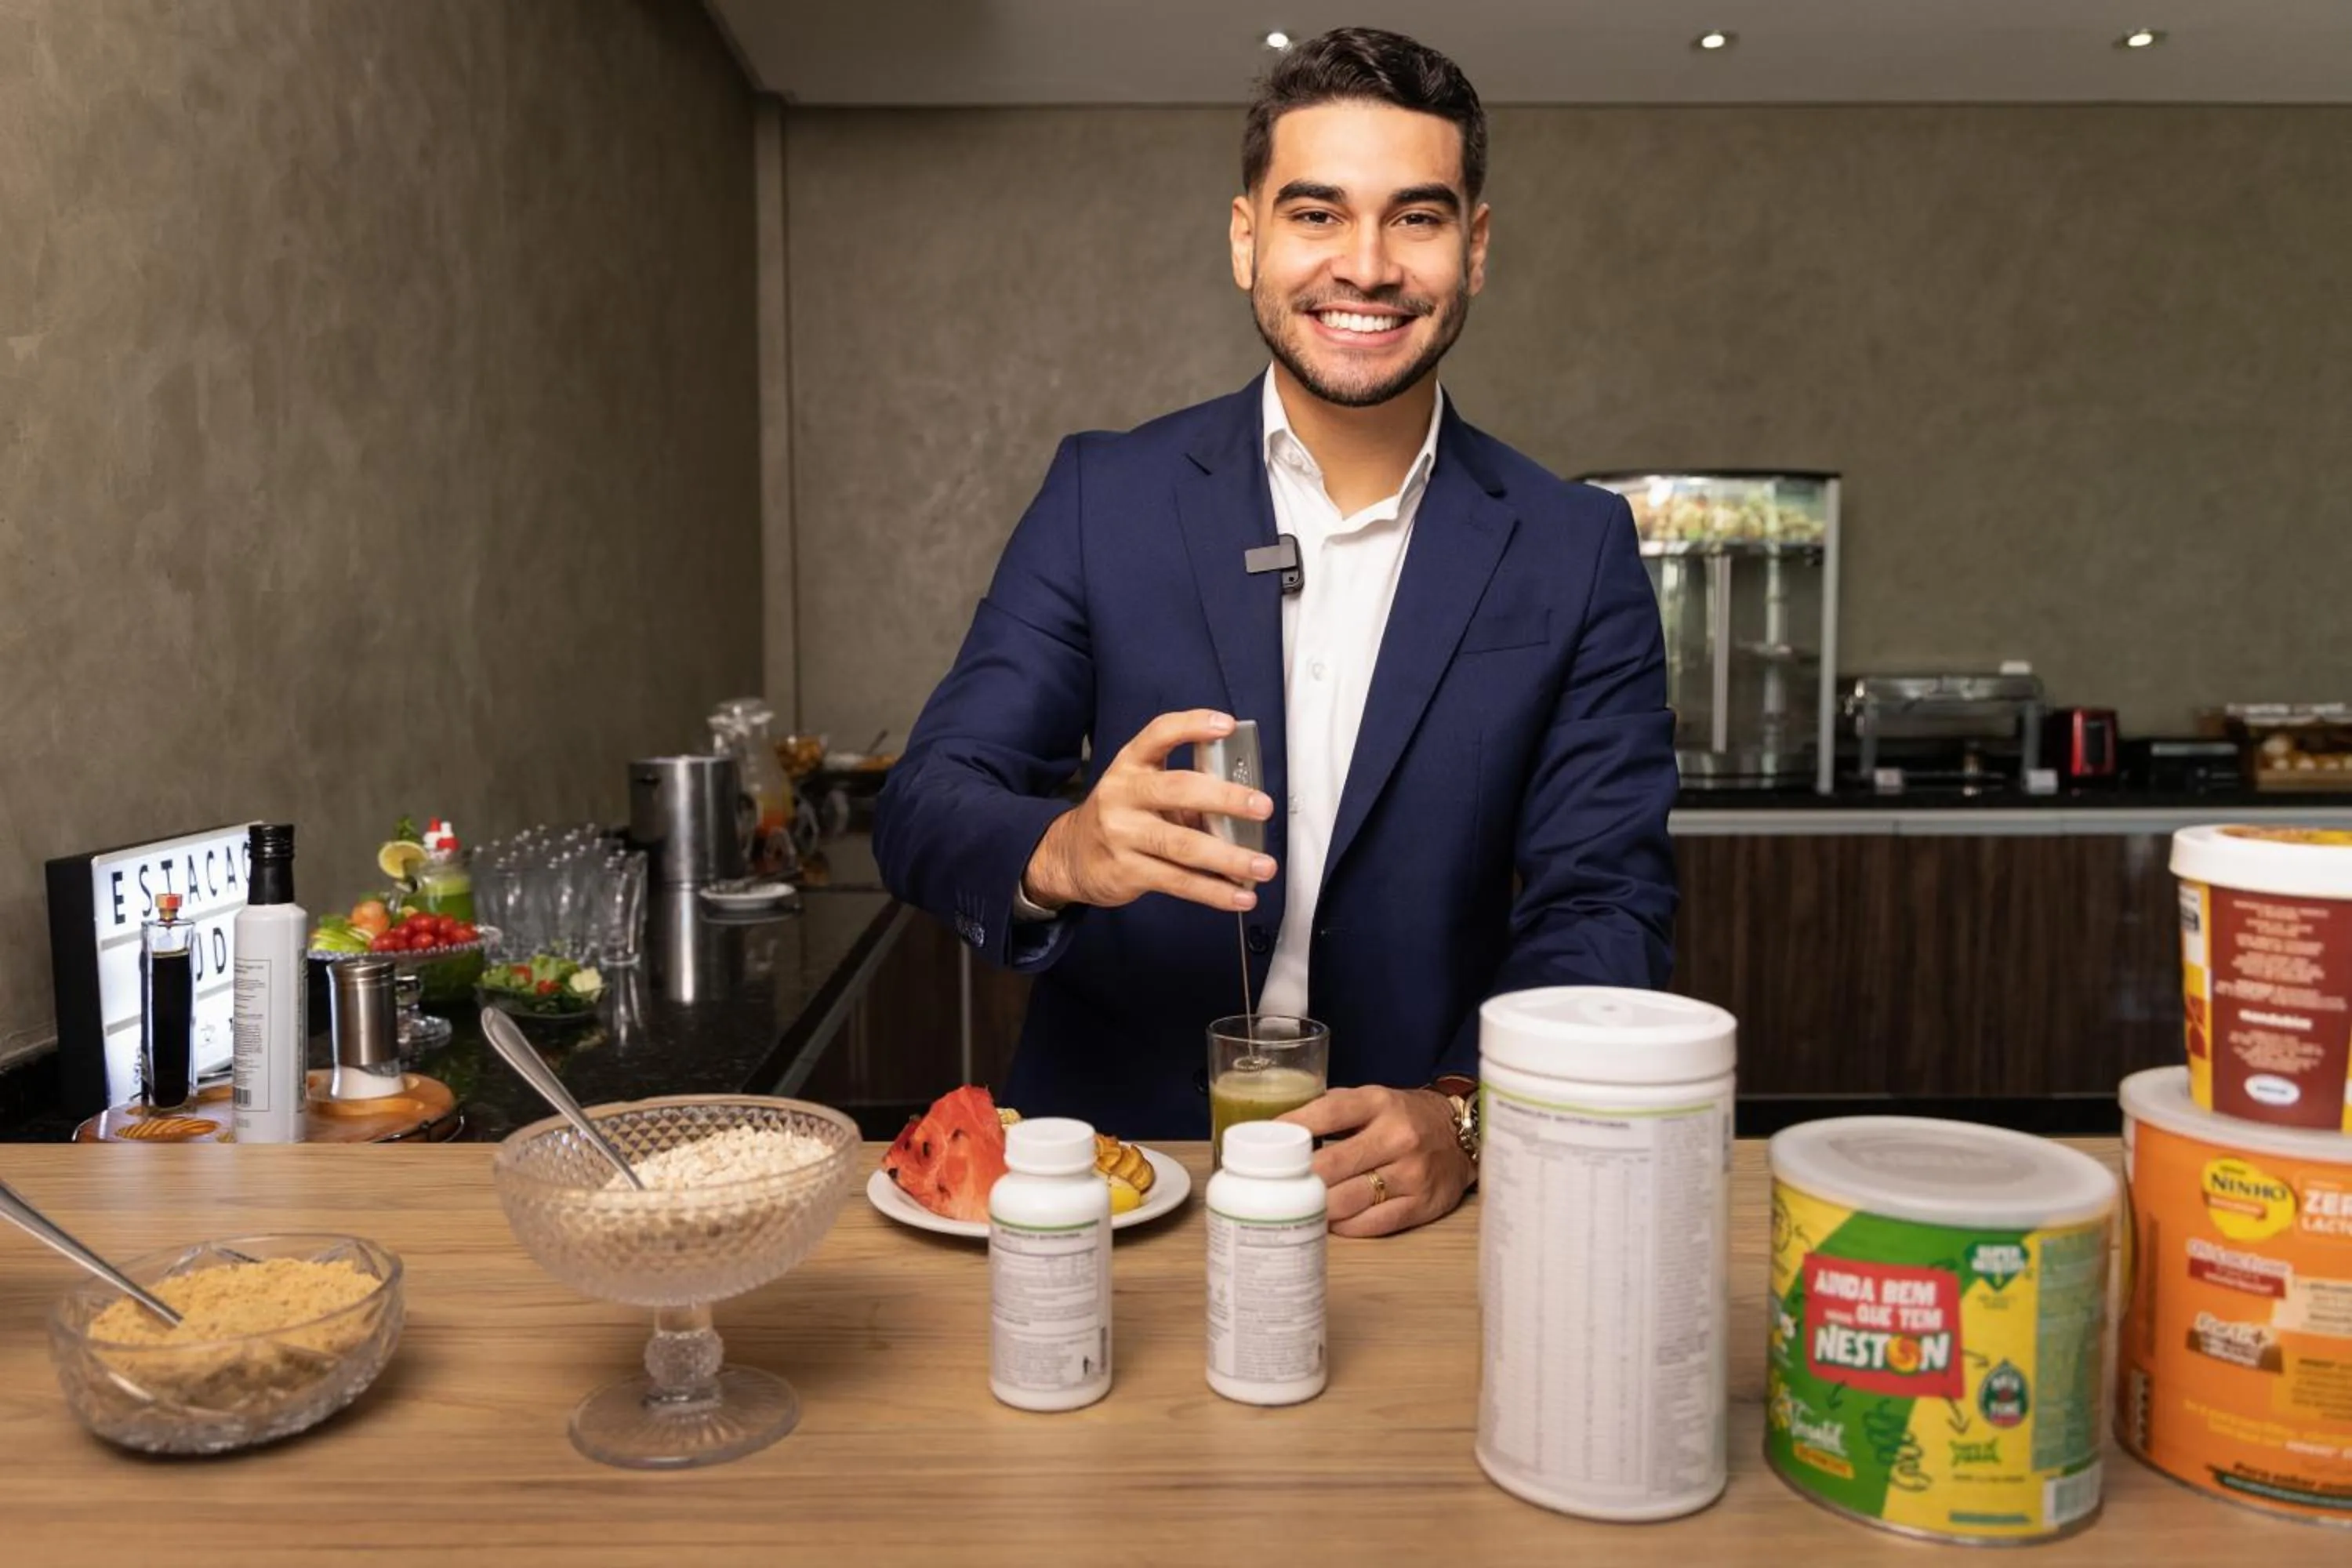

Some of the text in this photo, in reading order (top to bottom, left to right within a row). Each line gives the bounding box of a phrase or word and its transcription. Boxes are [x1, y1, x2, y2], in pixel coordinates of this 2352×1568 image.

[2210, 1172, 2288, 1201] NINHO
[1813, 1269, 1937, 1306] AINDA BEM
[1855, 1303, 1893, 1328] QUE
[1898, 1306, 1944, 1330] TEM
[1813, 1323, 1951, 1373] NESTON
